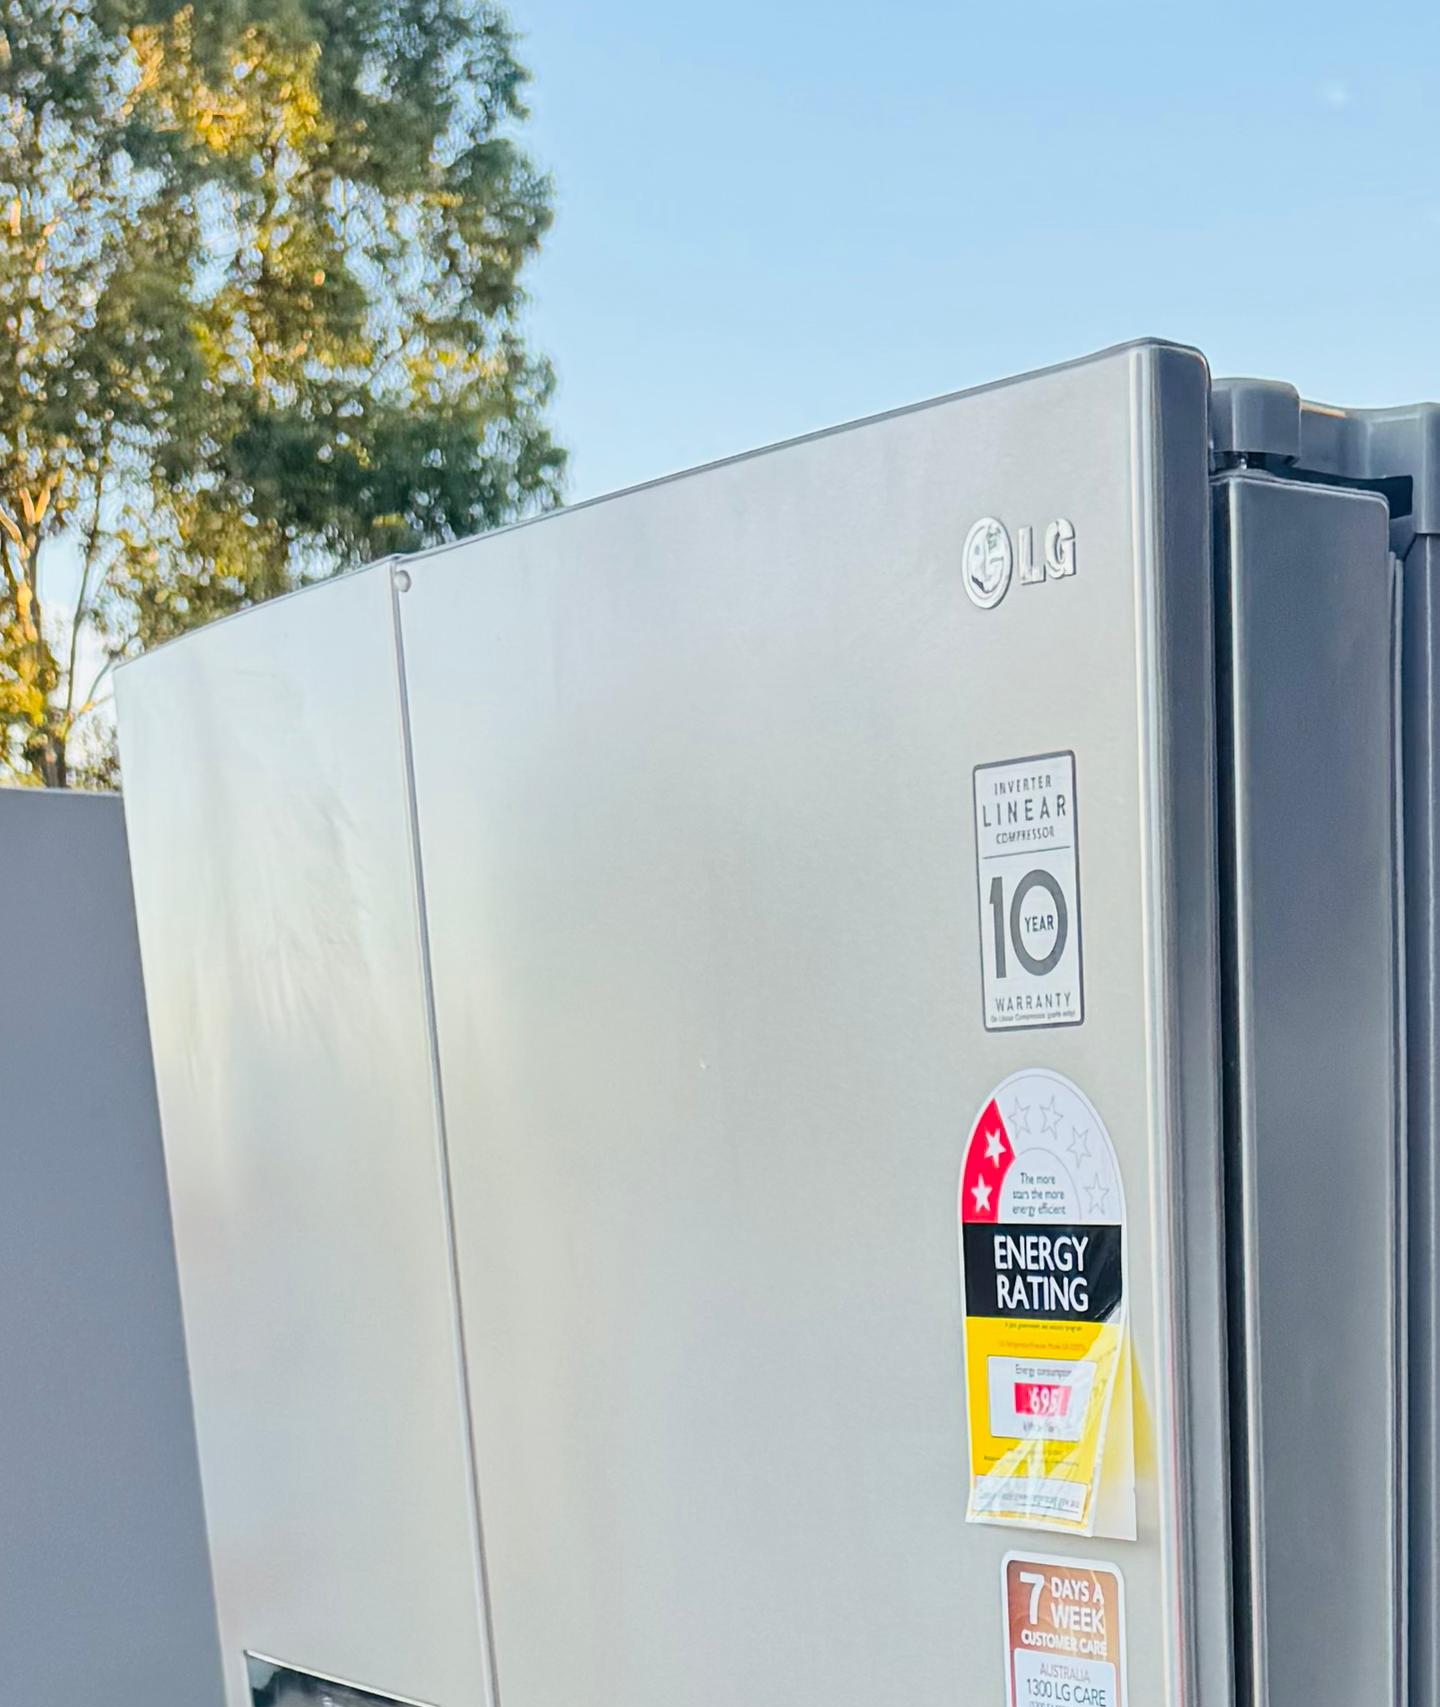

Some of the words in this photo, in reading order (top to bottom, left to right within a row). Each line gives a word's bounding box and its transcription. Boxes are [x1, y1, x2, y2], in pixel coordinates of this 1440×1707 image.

[1018, 518, 1077, 586] LG
[994, 774, 1053, 796] INVERTER
[982, 794, 1067, 828] LINEAR
[996, 825, 1055, 844] COMPRESSOR
[989, 868, 1068, 979] 10
[1024, 914, 1055, 934] YEAR
[995, 992, 1072, 1013] WARRANTY
[1020, 1171, 1034, 1185] The
[993, 1234, 1089, 1272] ENERGY
[996, 1273, 1089, 1312] RATING
[1020, 1571, 1045, 1625] 7
[1050, 1576, 1090, 1603] DAYS
[1092, 1582, 1105, 1606] A
[1050, 1602, 1106, 1635] WEEK
[1021, 1628, 1078, 1652] CUSTOMER
[1079, 1638, 1107, 1657] CARE
[1040, 1662, 1092, 1684] AUSTRALIA
[1026, 1677, 1053, 1699] 1300
[1054, 1682, 1071, 1702] LG
[1073, 1685, 1107, 1707] CARE
